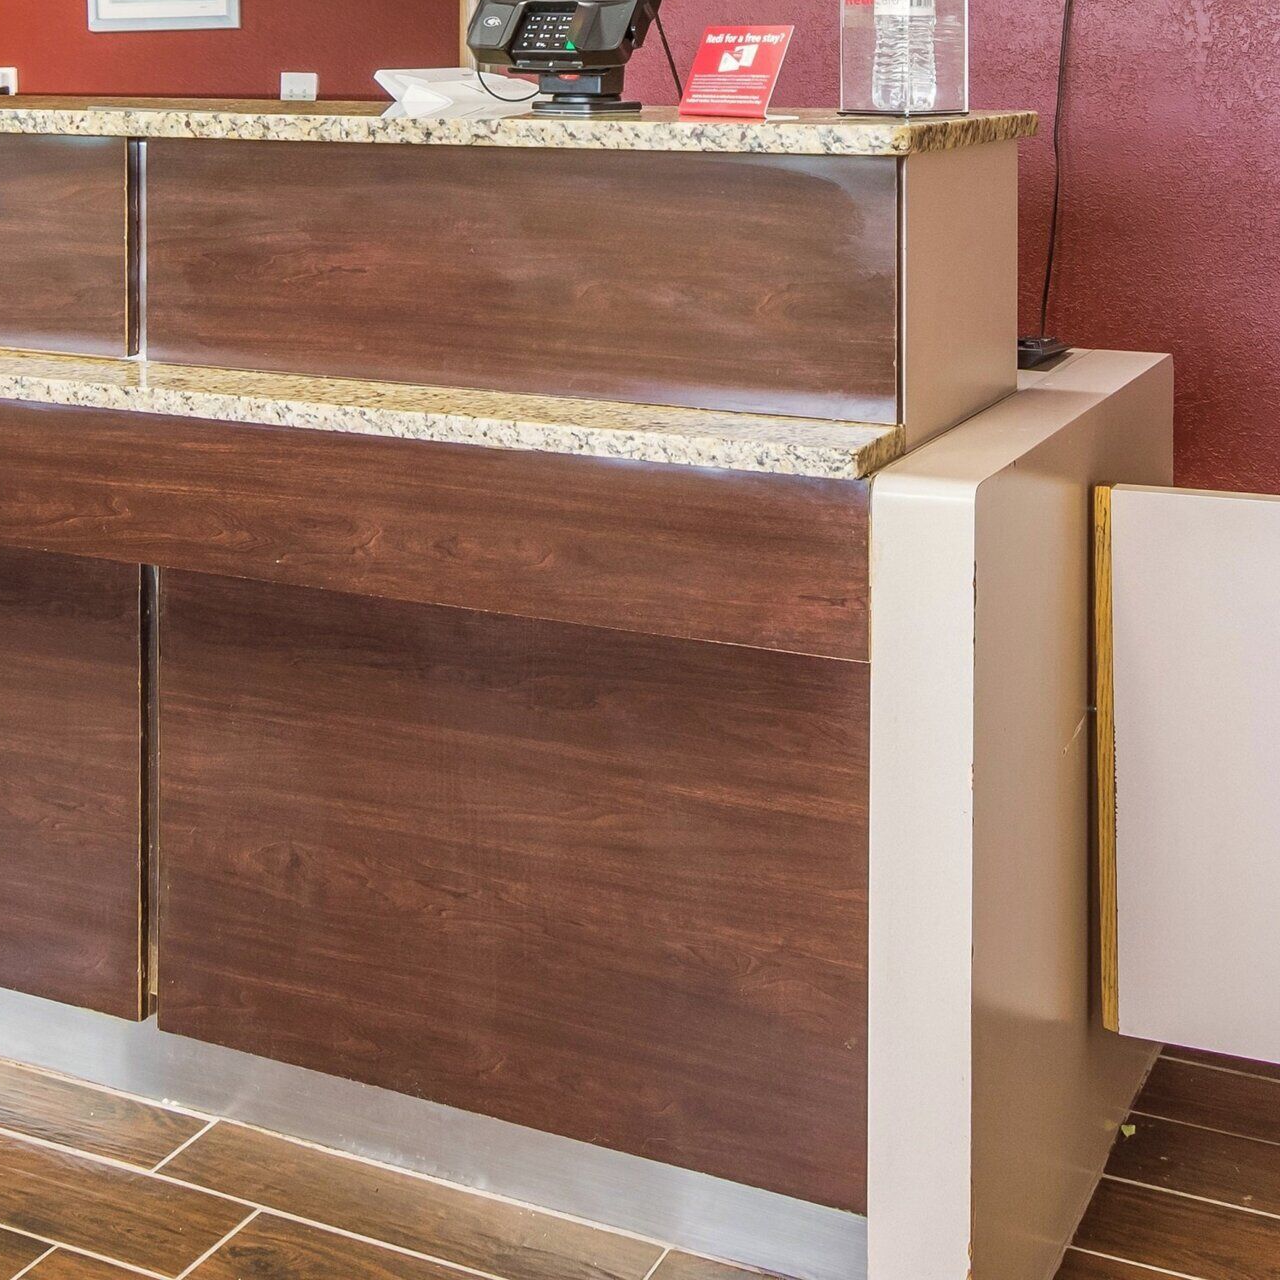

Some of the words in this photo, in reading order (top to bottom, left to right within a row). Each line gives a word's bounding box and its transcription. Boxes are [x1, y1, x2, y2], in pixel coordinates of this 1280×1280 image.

[706, 33, 724, 44] Redi
[724, 33, 737, 44] for
[737, 35, 744, 43] a
[744, 32, 761, 43] free
[762, 32, 786, 45] stay?
